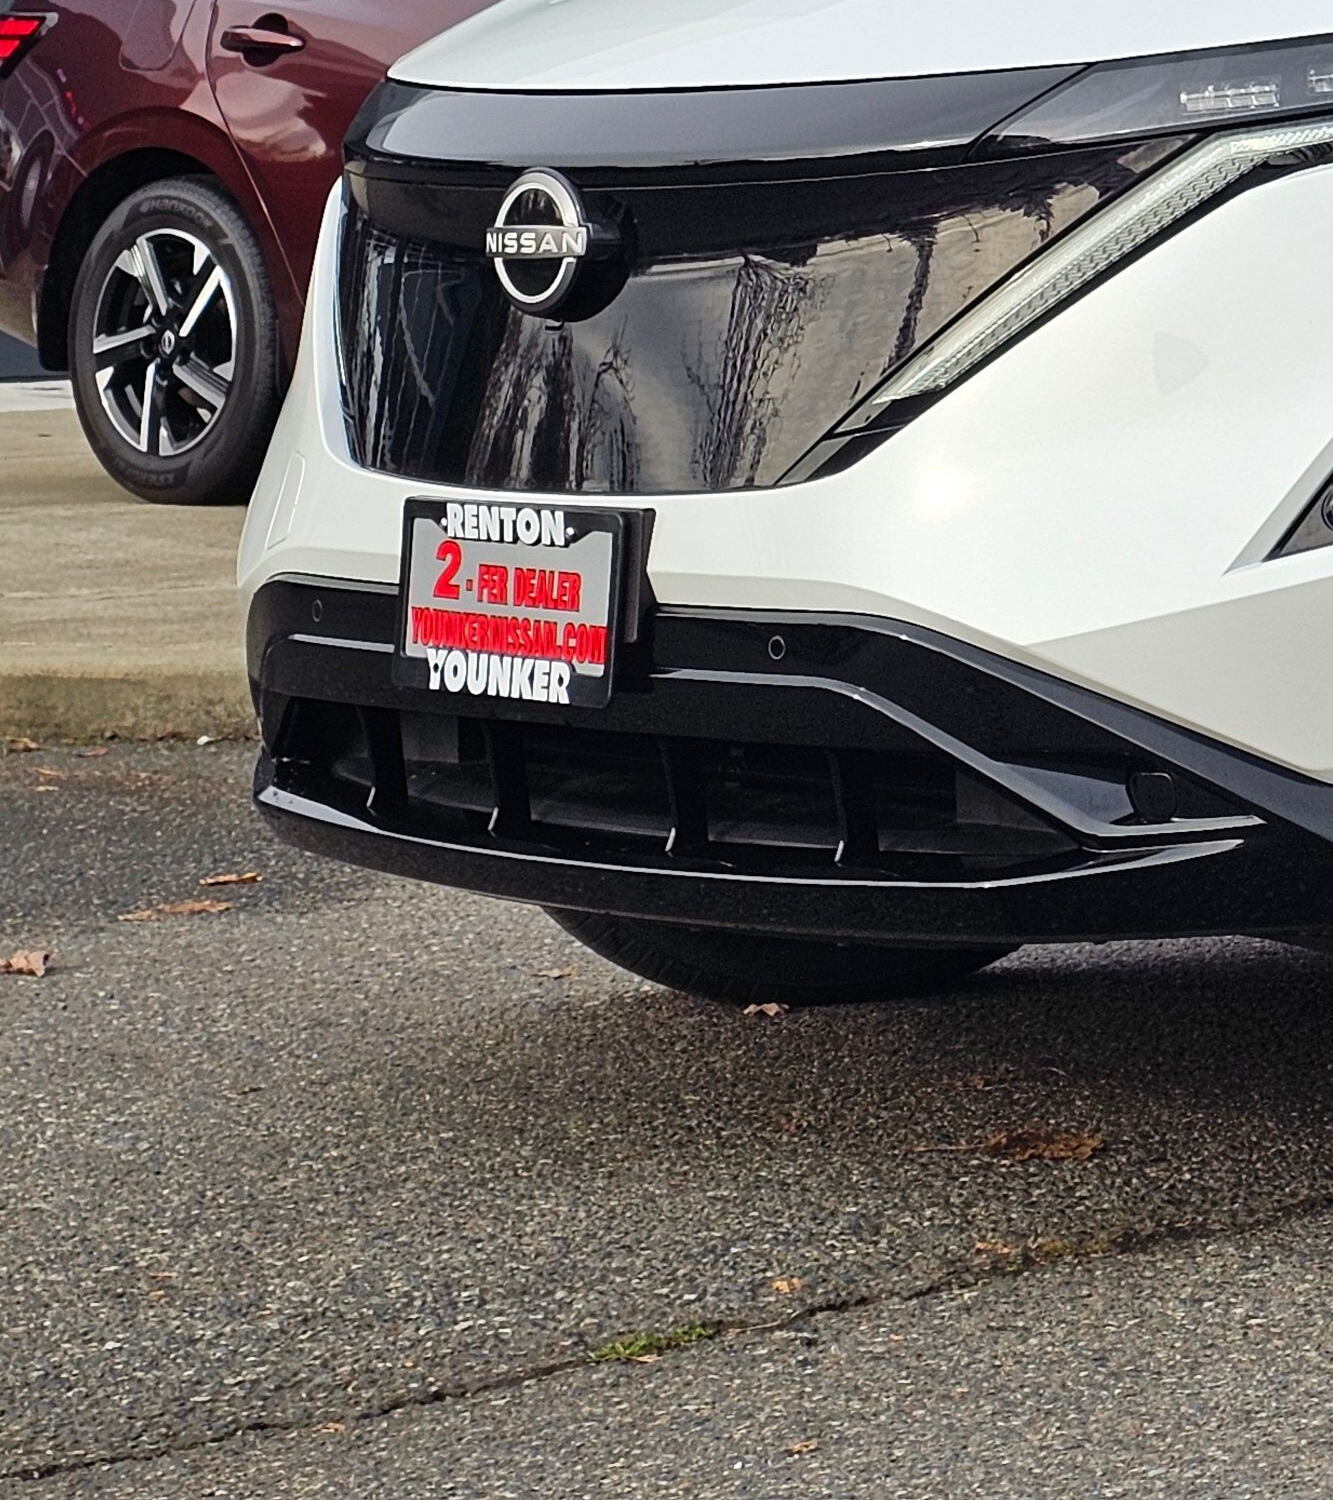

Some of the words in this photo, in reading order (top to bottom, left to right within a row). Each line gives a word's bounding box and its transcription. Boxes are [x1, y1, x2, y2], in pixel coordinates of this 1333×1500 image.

[486, 232, 584, 254] NISSAN
[446, 502, 567, 546] RENTON
[513, 567, 582, 612] DEALER
[411, 606, 608, 664] YOUNKERNISSAN.COM
[427, 649, 571, 705] YOUNKER
